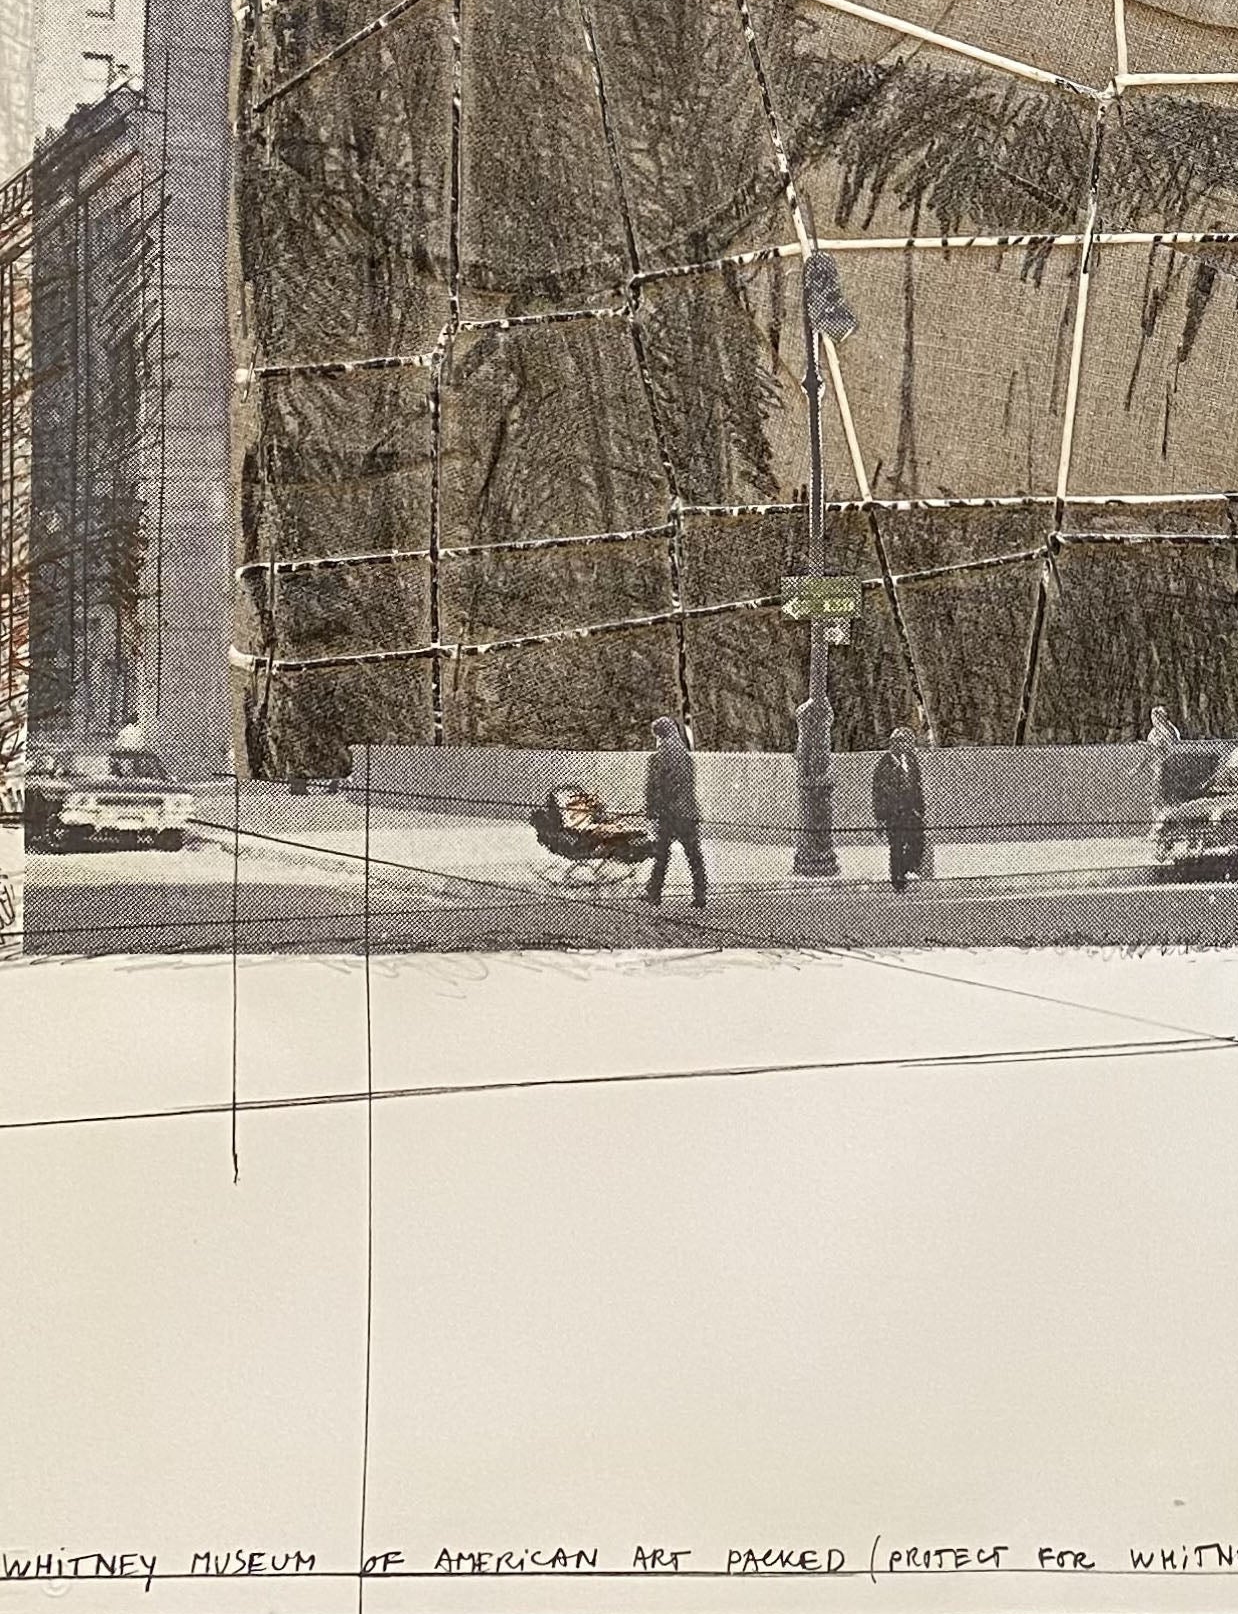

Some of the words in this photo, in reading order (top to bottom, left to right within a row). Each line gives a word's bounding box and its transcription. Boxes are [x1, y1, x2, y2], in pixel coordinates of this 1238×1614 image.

[191, 1549, 315, 1574] MUSEUM
[362, 1551, 405, 1574] OF
[633, 1545, 692, 1571] ART
[727, 1548, 846, 1574] PACKED
[1038, 1546, 1096, 1570] FOR
